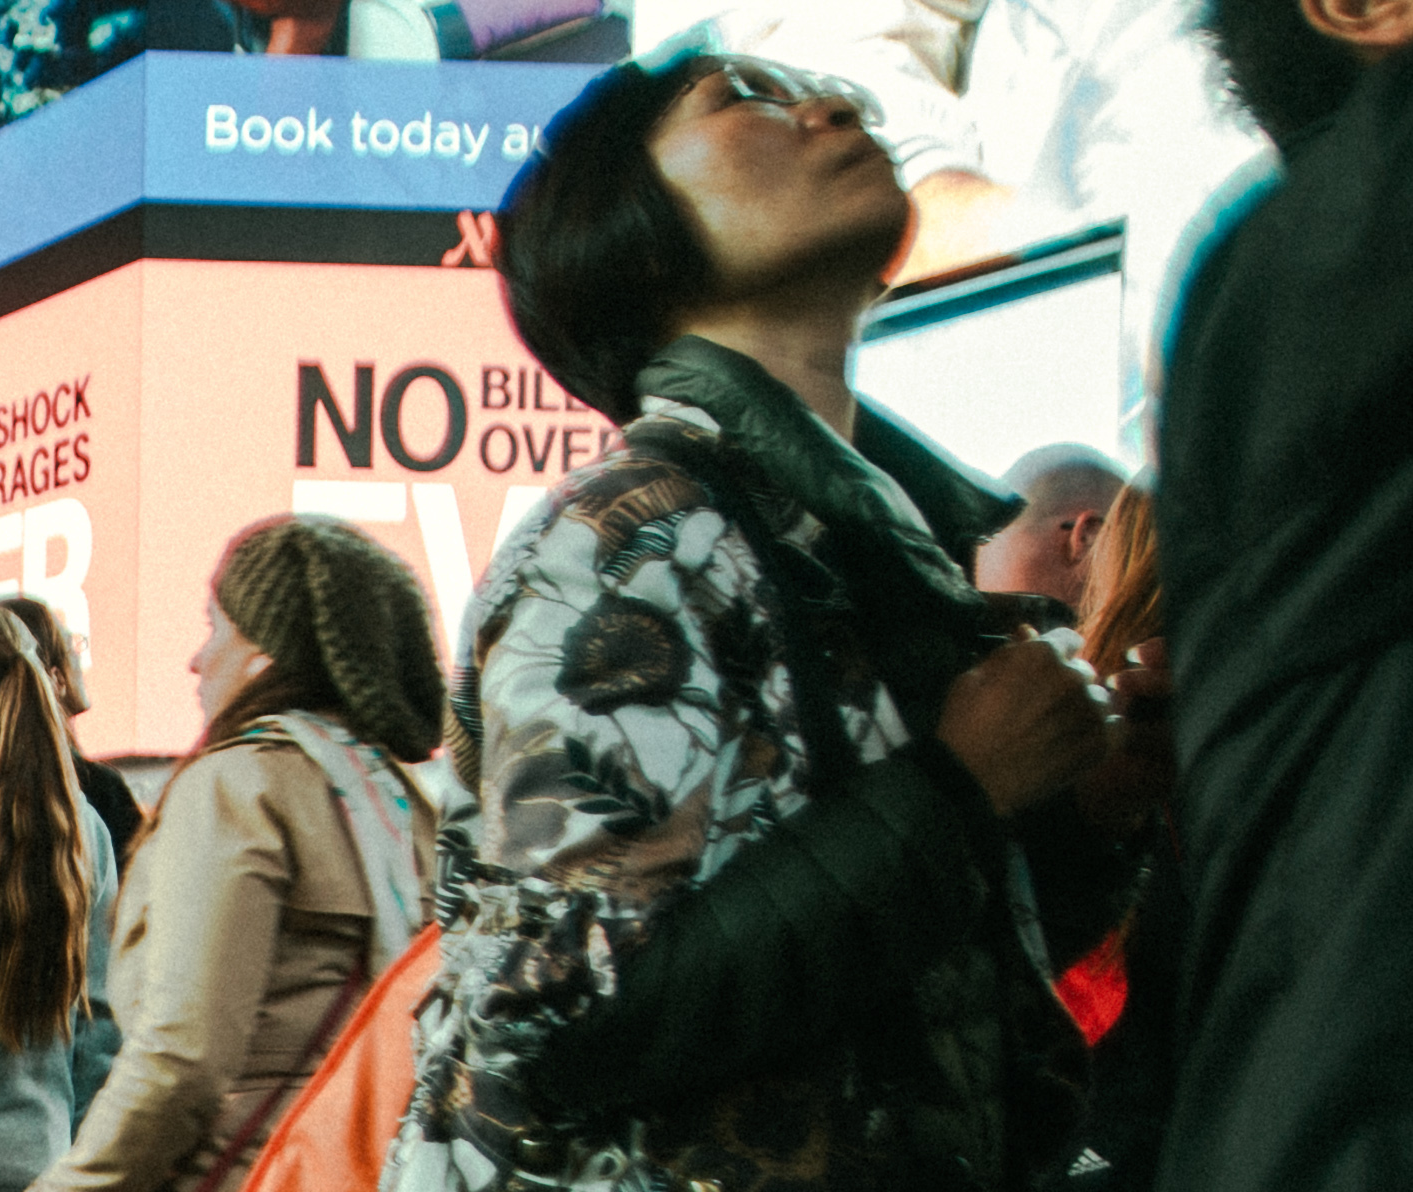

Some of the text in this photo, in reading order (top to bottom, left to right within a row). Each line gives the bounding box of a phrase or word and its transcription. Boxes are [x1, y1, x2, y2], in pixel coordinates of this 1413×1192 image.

[204, 104, 333, 153] Book
[351, 110, 490, 164] today
[295, 360, 468, 473] NO
